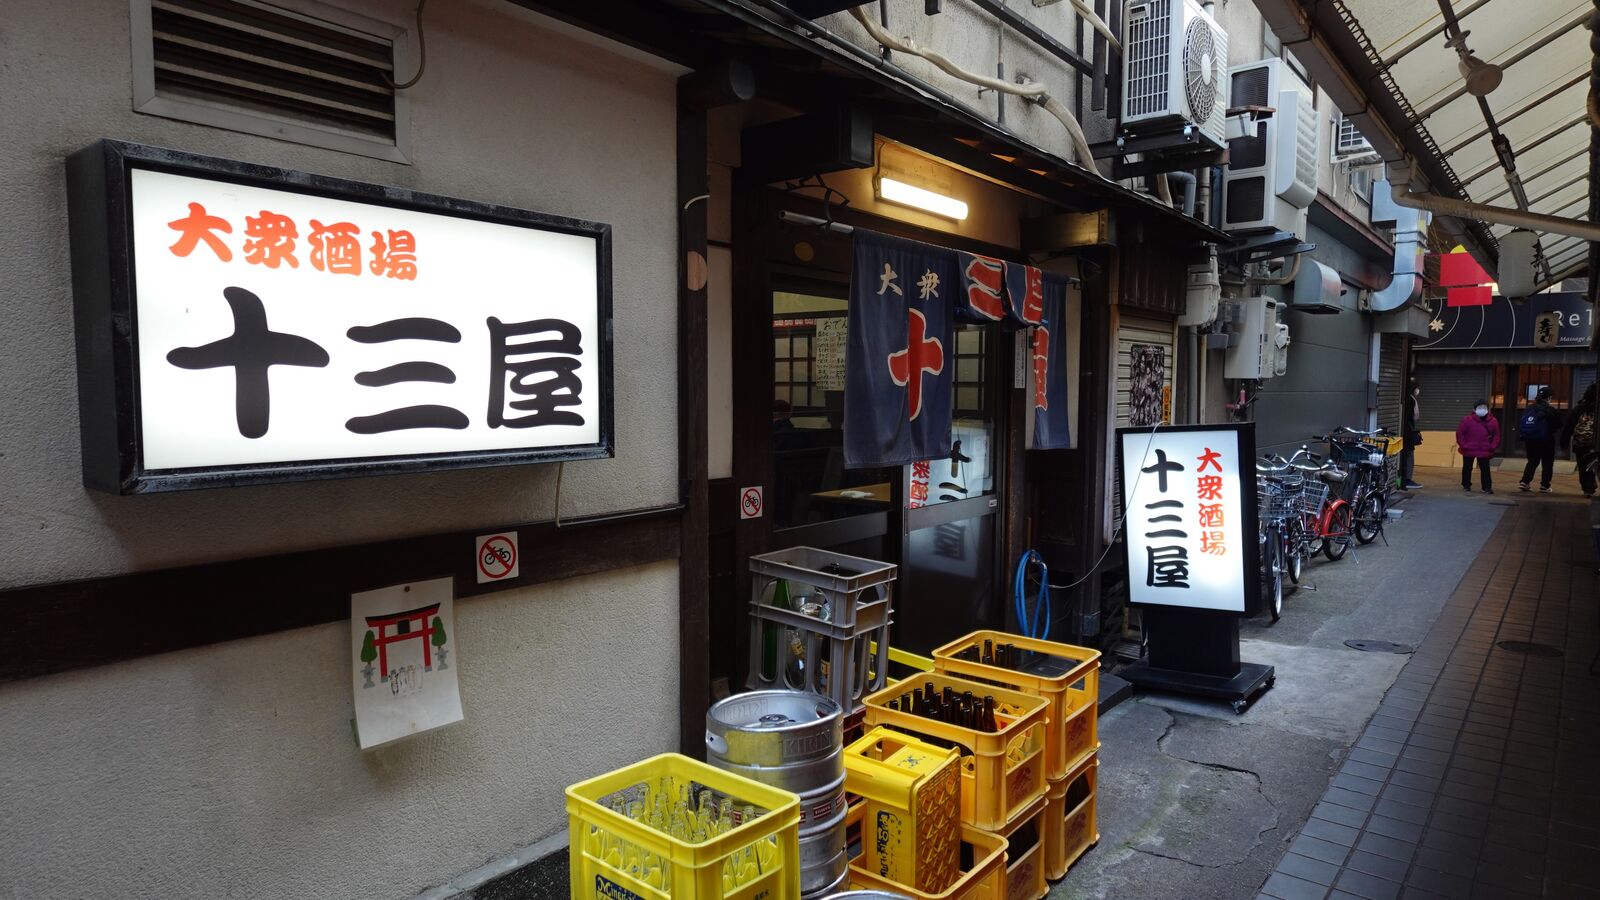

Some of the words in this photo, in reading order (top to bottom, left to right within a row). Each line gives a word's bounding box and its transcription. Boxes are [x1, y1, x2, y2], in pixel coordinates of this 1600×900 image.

[167, 202, 418, 281] 大衆酒場
[876, 262, 941, 301] 大衆
[166, 286, 585, 440] 十三屋
[1141, 448, 1190, 589] 十三屋
[1196, 447, 1227, 556] 大衆酒場
